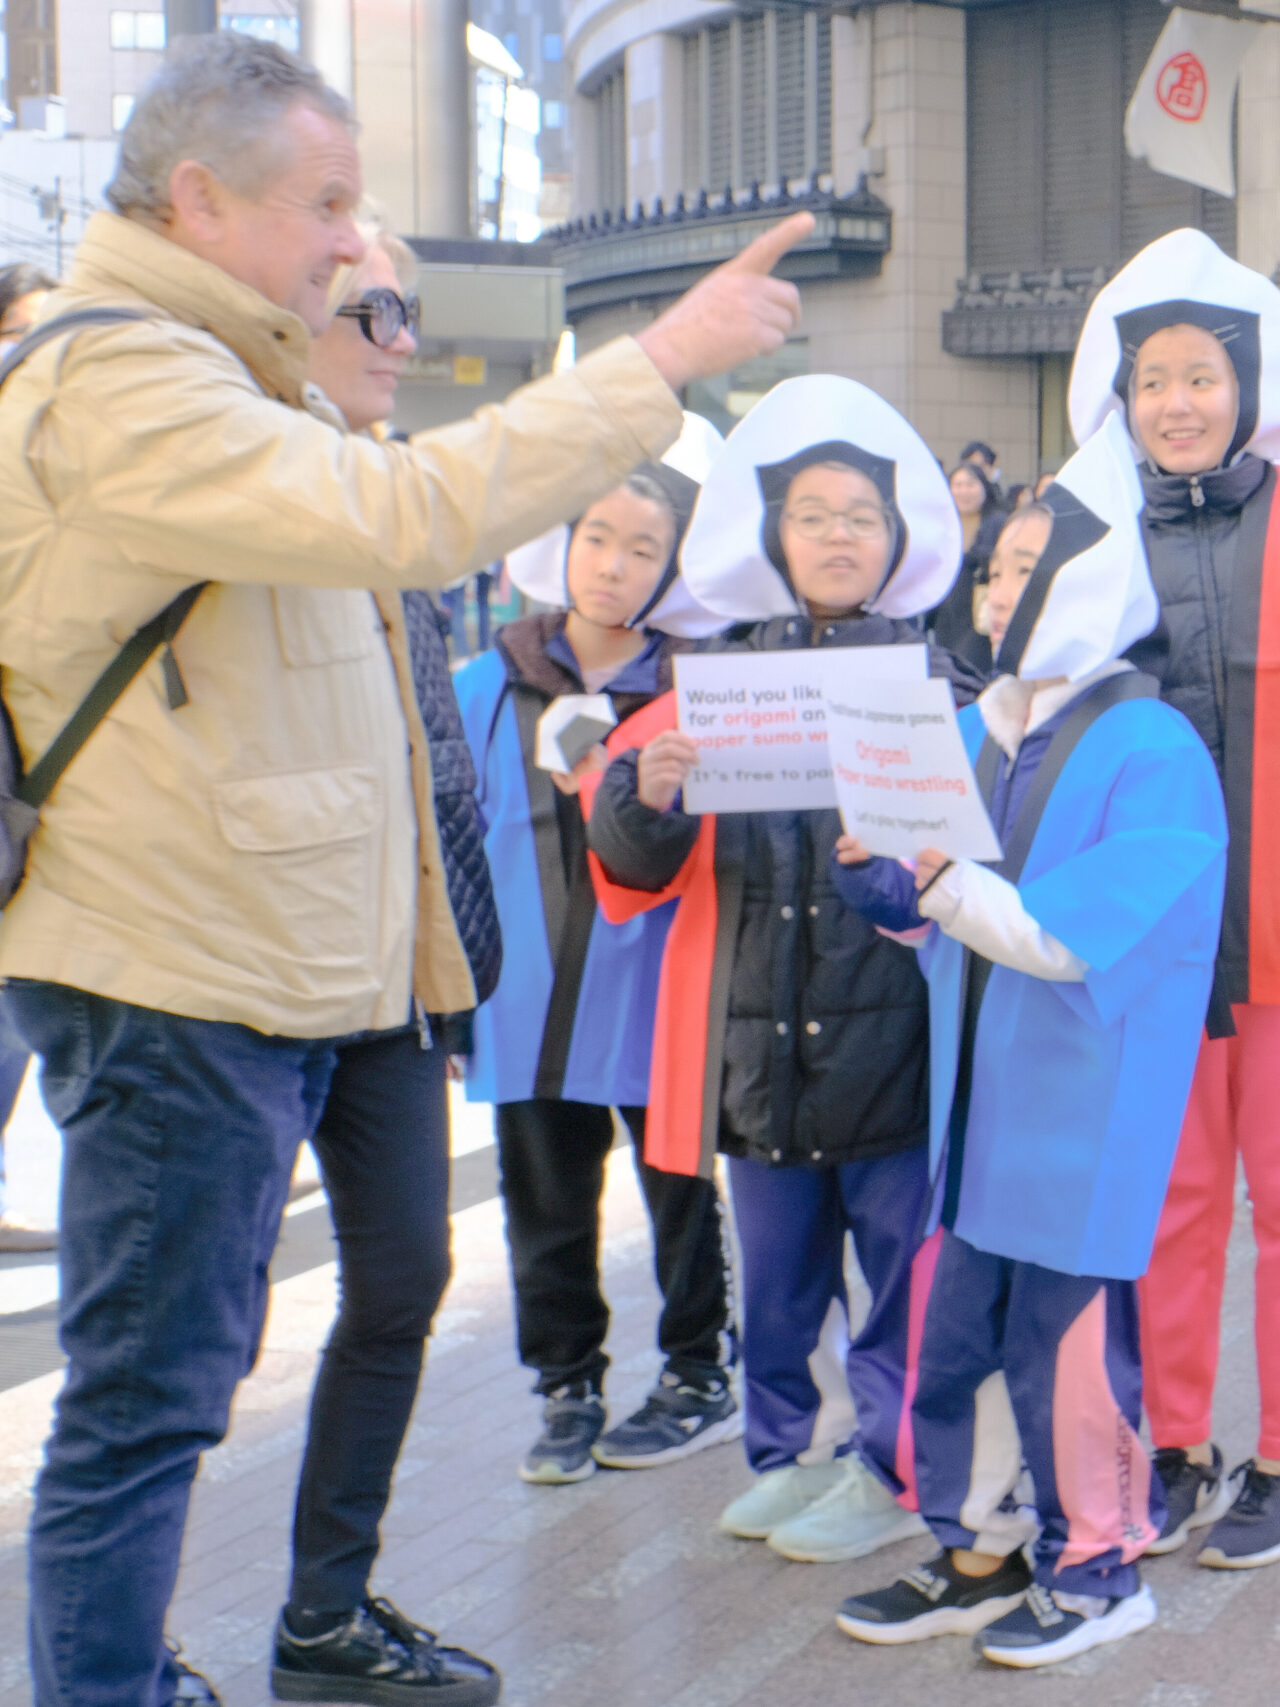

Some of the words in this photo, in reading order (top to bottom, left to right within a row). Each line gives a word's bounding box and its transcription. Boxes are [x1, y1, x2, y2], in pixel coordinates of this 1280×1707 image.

[686, 688, 746, 704] Would
[752, 689, 786, 706] you
[687, 711, 717, 726] for
[724, 707, 797, 728] origami
[753, 731, 803, 747] sumo
[856, 739, 911, 769] Origami
[692, 769, 729, 783] It's
[736, 768, 775, 781] free
[782, 768, 800, 781] to
[895, 775, 967, 797] wrestling
